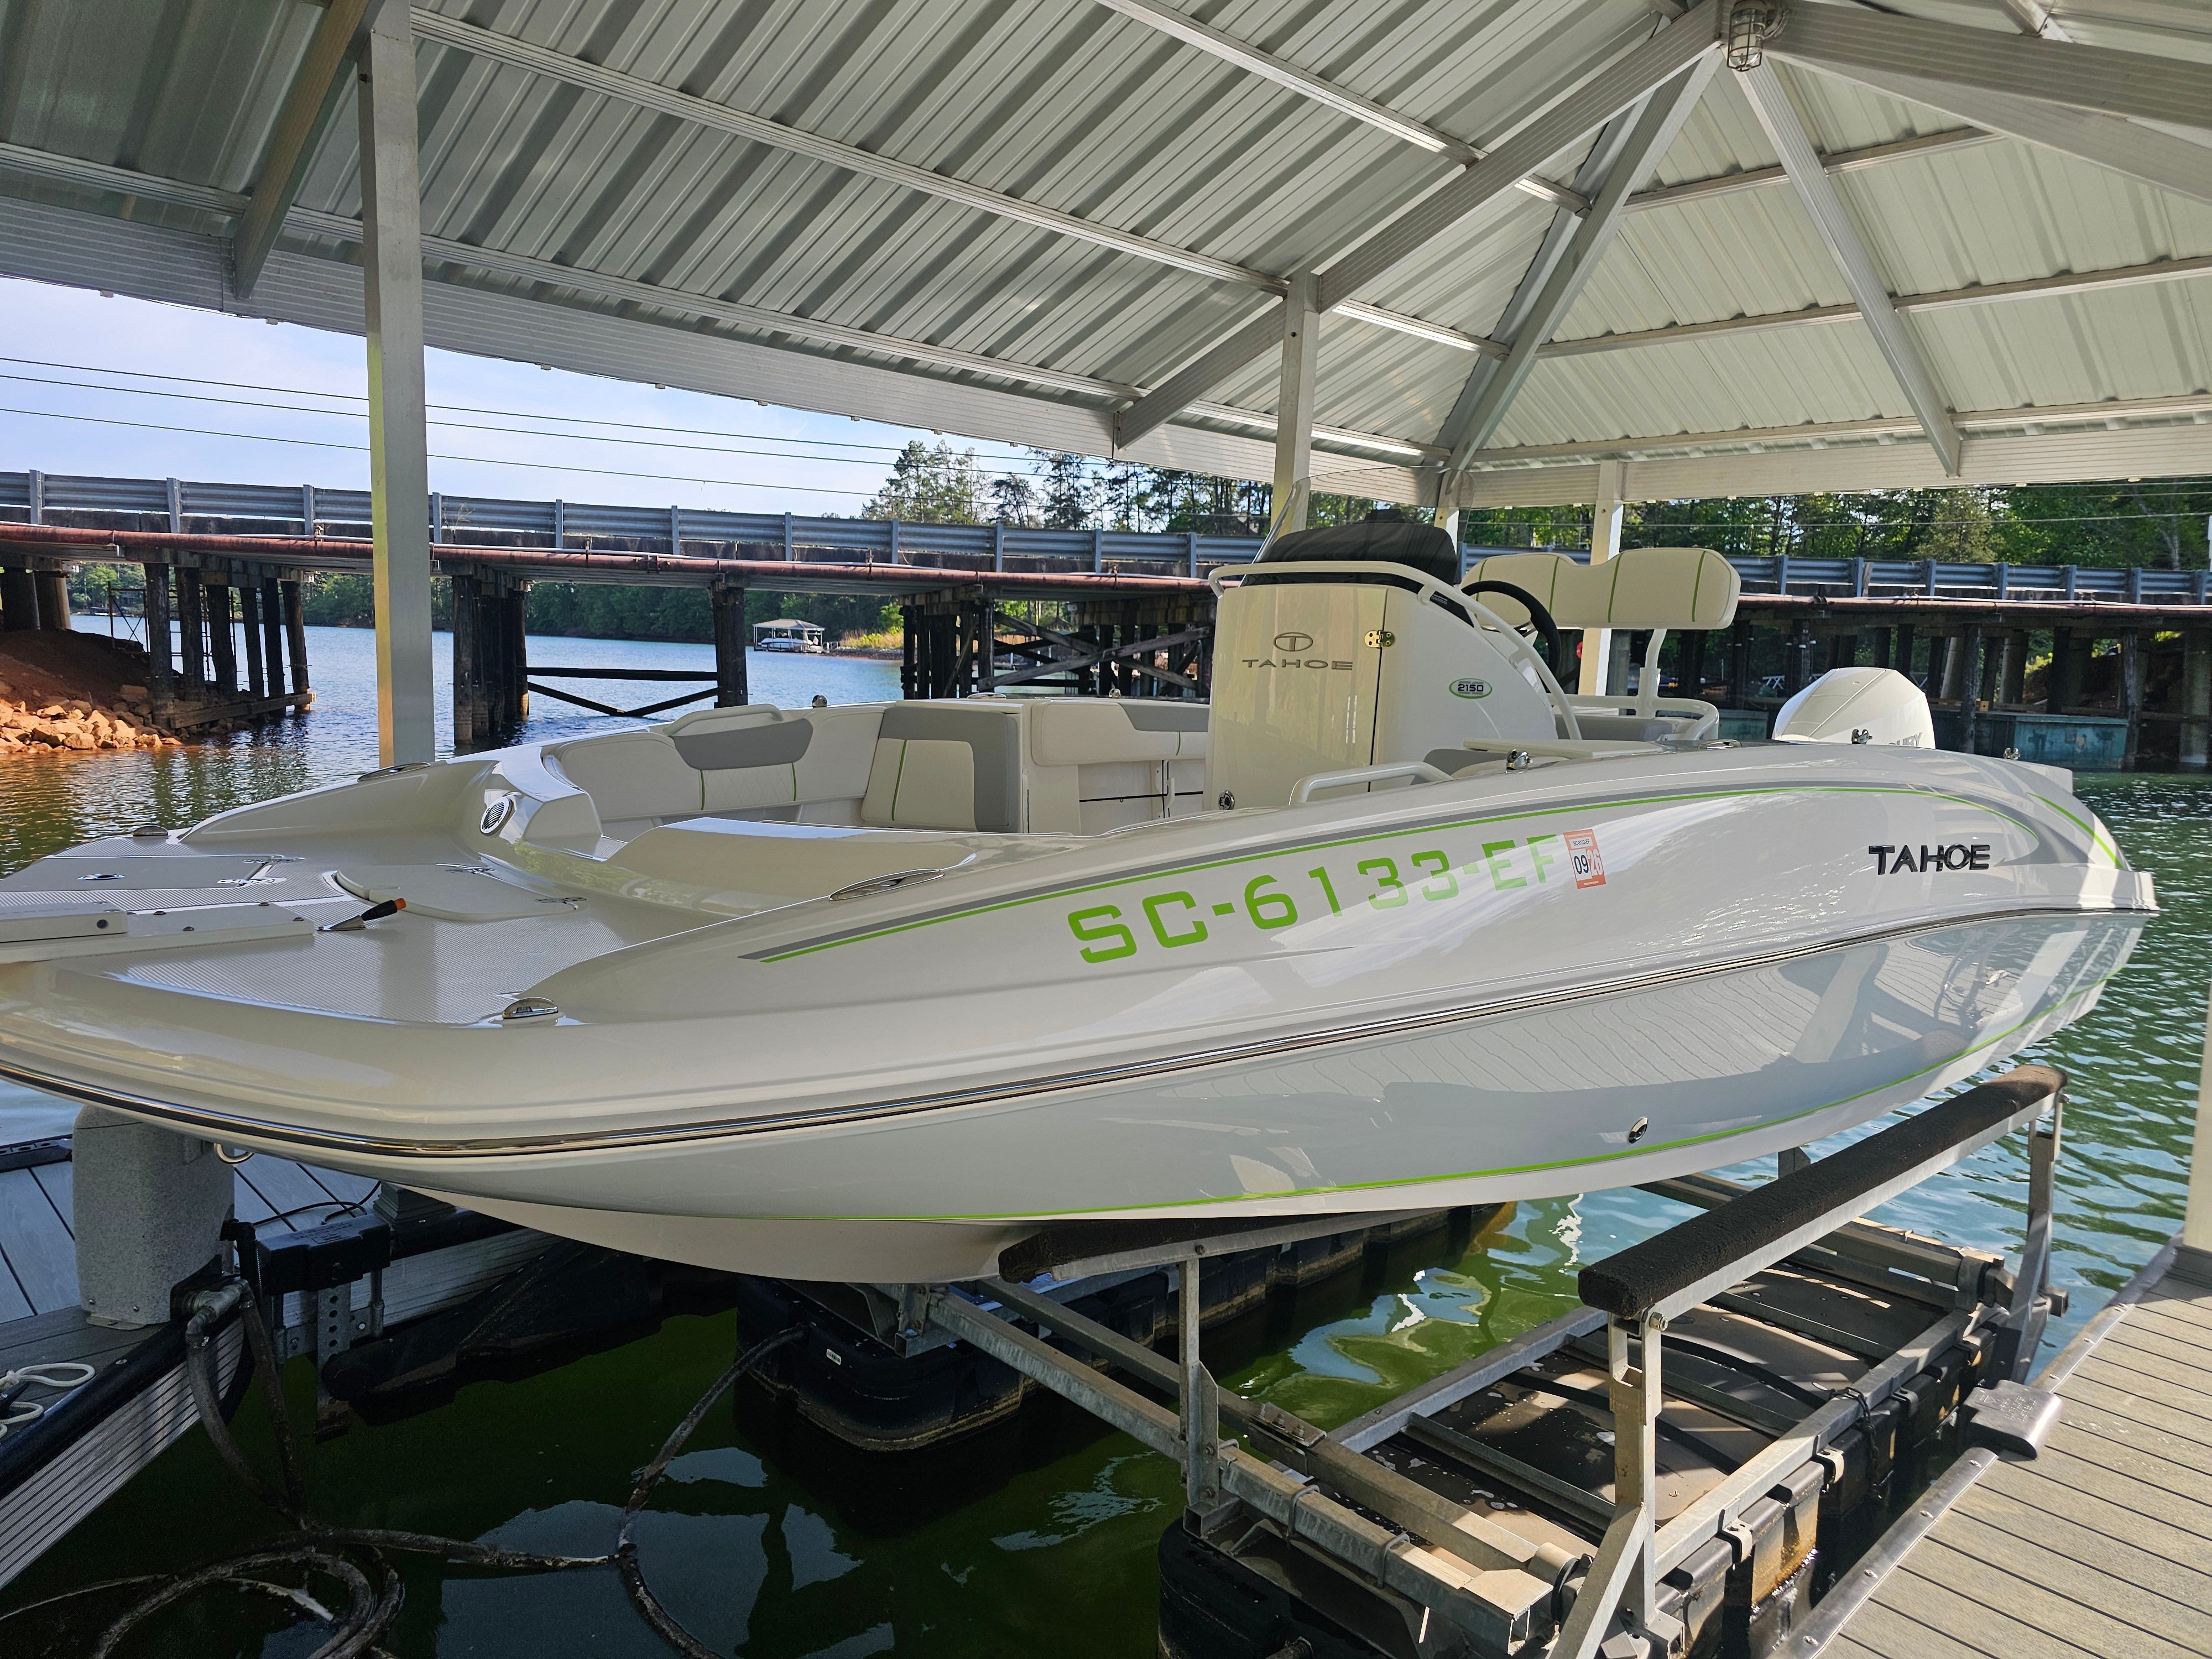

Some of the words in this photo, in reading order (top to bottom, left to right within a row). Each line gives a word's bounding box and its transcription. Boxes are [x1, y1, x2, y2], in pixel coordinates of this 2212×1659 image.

[1242, 659, 1353, 671] TAHOE
[1458, 684, 1484, 692] 2150
[1574, 854, 1589, 874] 09
[1587, 849, 1603, 877] 26
[1869, 843, 1990, 875] TAHOE
[1067, 834, 1558, 963] SC-6133-EF
